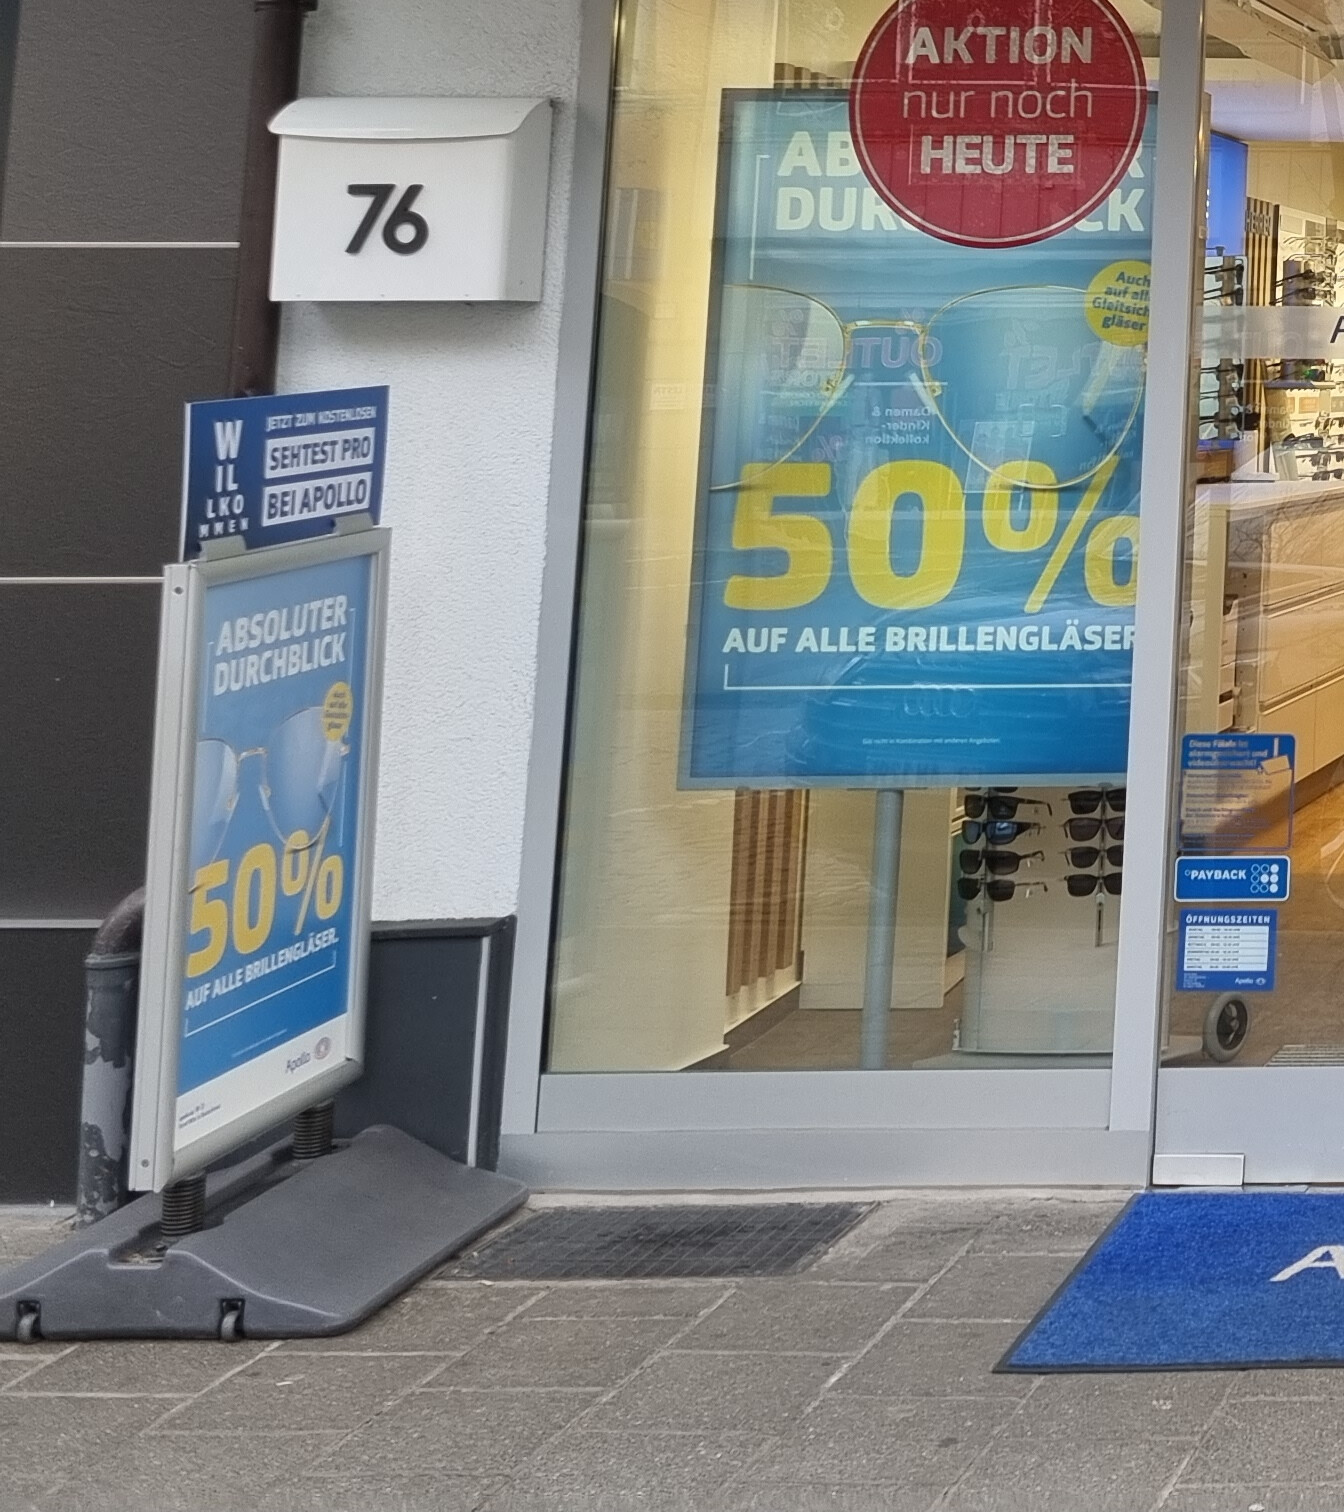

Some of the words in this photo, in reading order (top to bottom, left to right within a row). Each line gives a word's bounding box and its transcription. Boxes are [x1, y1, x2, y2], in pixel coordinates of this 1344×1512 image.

[905, 25, 1093, 64] AKTION
[902, 88, 976, 119] nur
[992, 78, 1093, 119] noch
[920, 134, 1075, 174] HEUTE
[345, 183, 430, 256] 76
[1131, 289, 1151, 301] all
[266, 414, 294, 432] JETZT
[295, 411, 316, 427] ZUM
[318, 406, 377, 425] KOSTENLOSEN
[269, 440, 339, 471] SEHTEST
[341, 435, 372, 461] PRO
[267, 489, 296, 520] BEI
[299, 478, 368, 515] APOLLO
[723, 456, 1140, 613] 50%
[215, 594, 347, 656] ABSOLUTER
[723, 627, 788, 653] AUF
[795, 626, 876, 653] ALLE
[213, 632, 346, 696] DURCHBLICK
[1190, 869, 1247, 881] PAYBACK
[186, 816, 344, 978] 50%
[1185, 913, 1271, 924] ÖFFNUNGSZEITEN
[184, 982, 211, 1012] AUF
[214, 969, 244, 999] ALLE
[285, 1052, 312, 1074] Apollo
